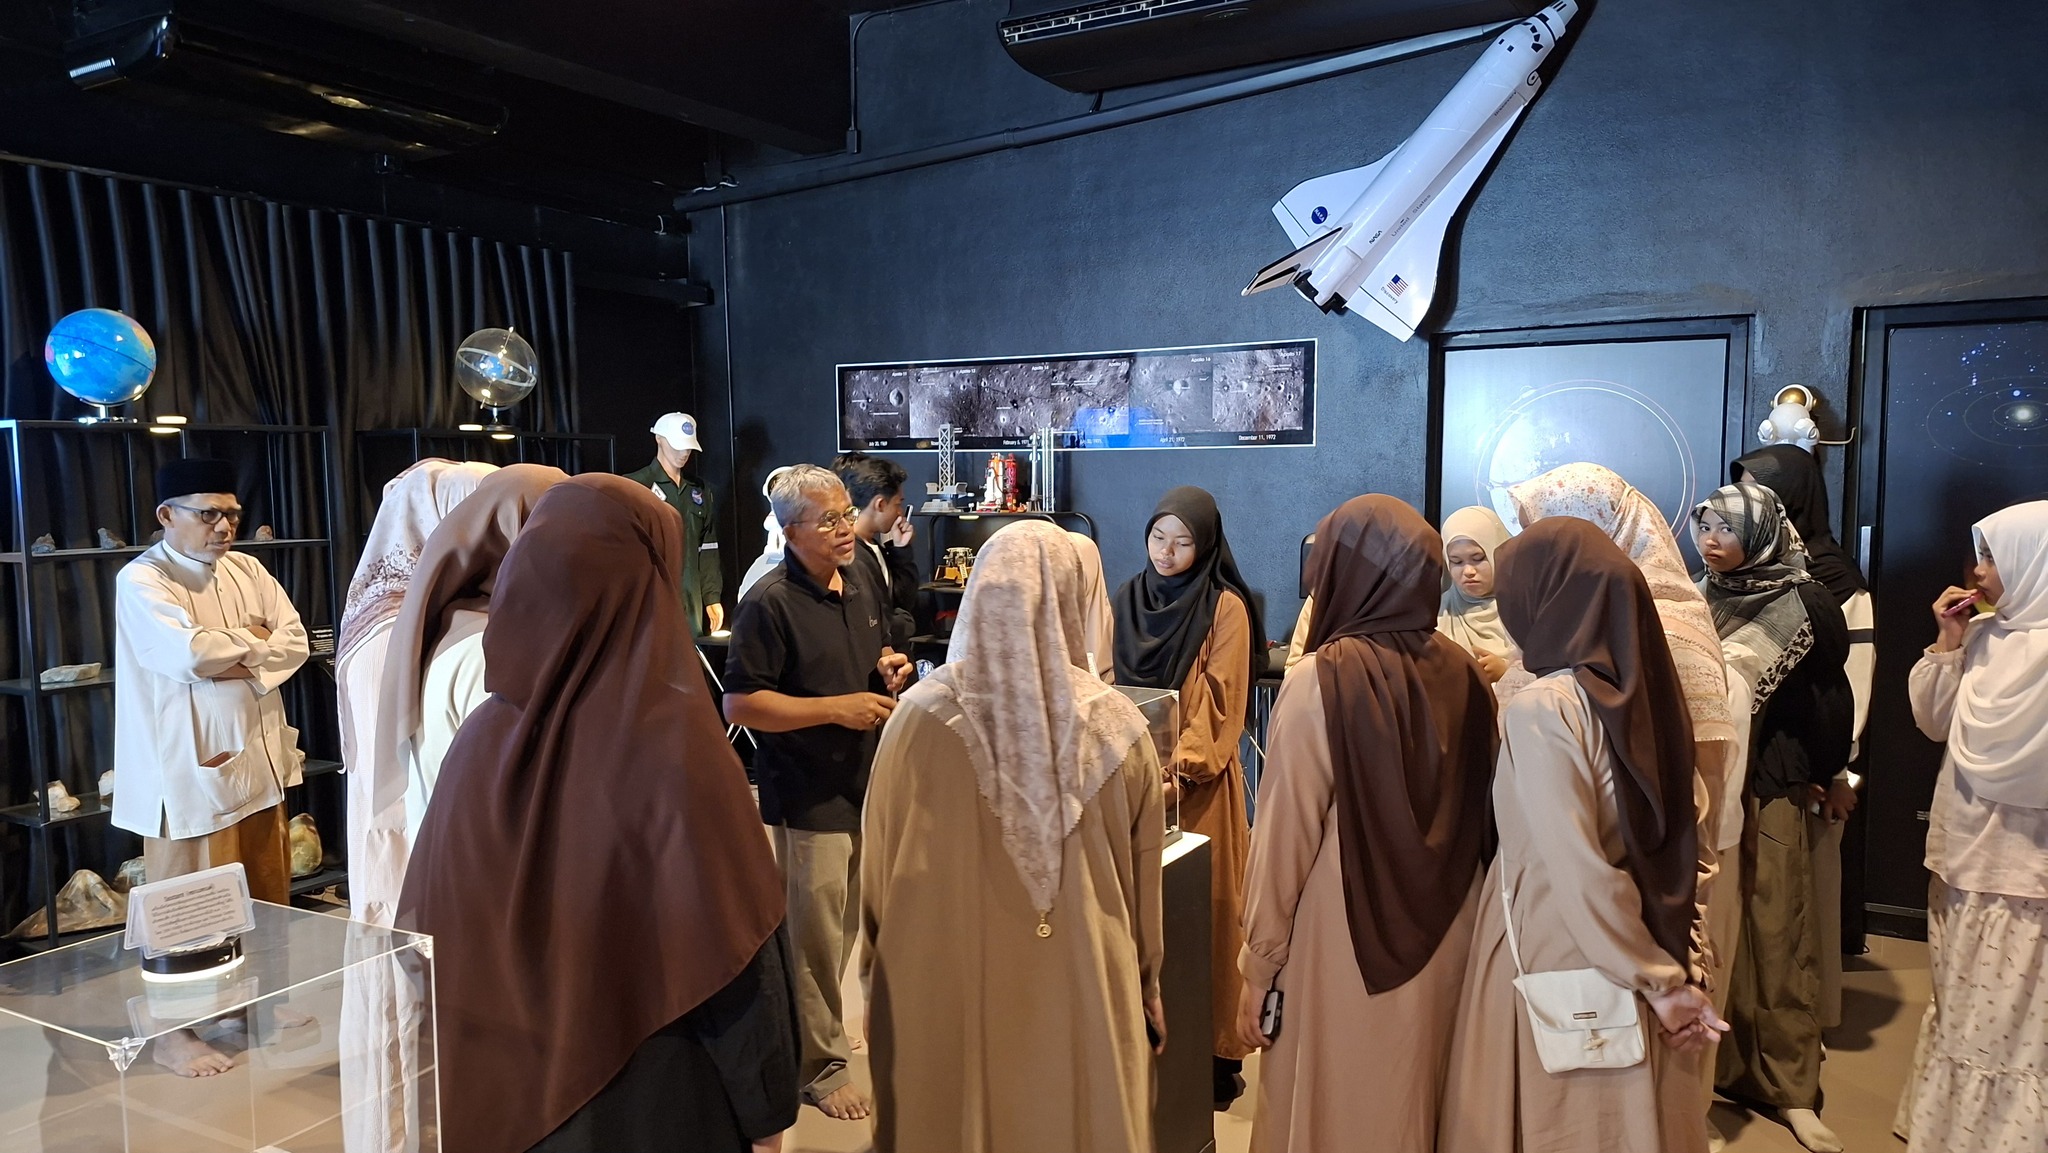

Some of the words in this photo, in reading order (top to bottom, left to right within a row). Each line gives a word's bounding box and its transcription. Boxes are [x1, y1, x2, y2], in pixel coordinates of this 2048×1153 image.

[1391, 217, 1410, 237] United
[1412, 194, 1431, 214] States
[1368, 230, 1382, 244] NASA
